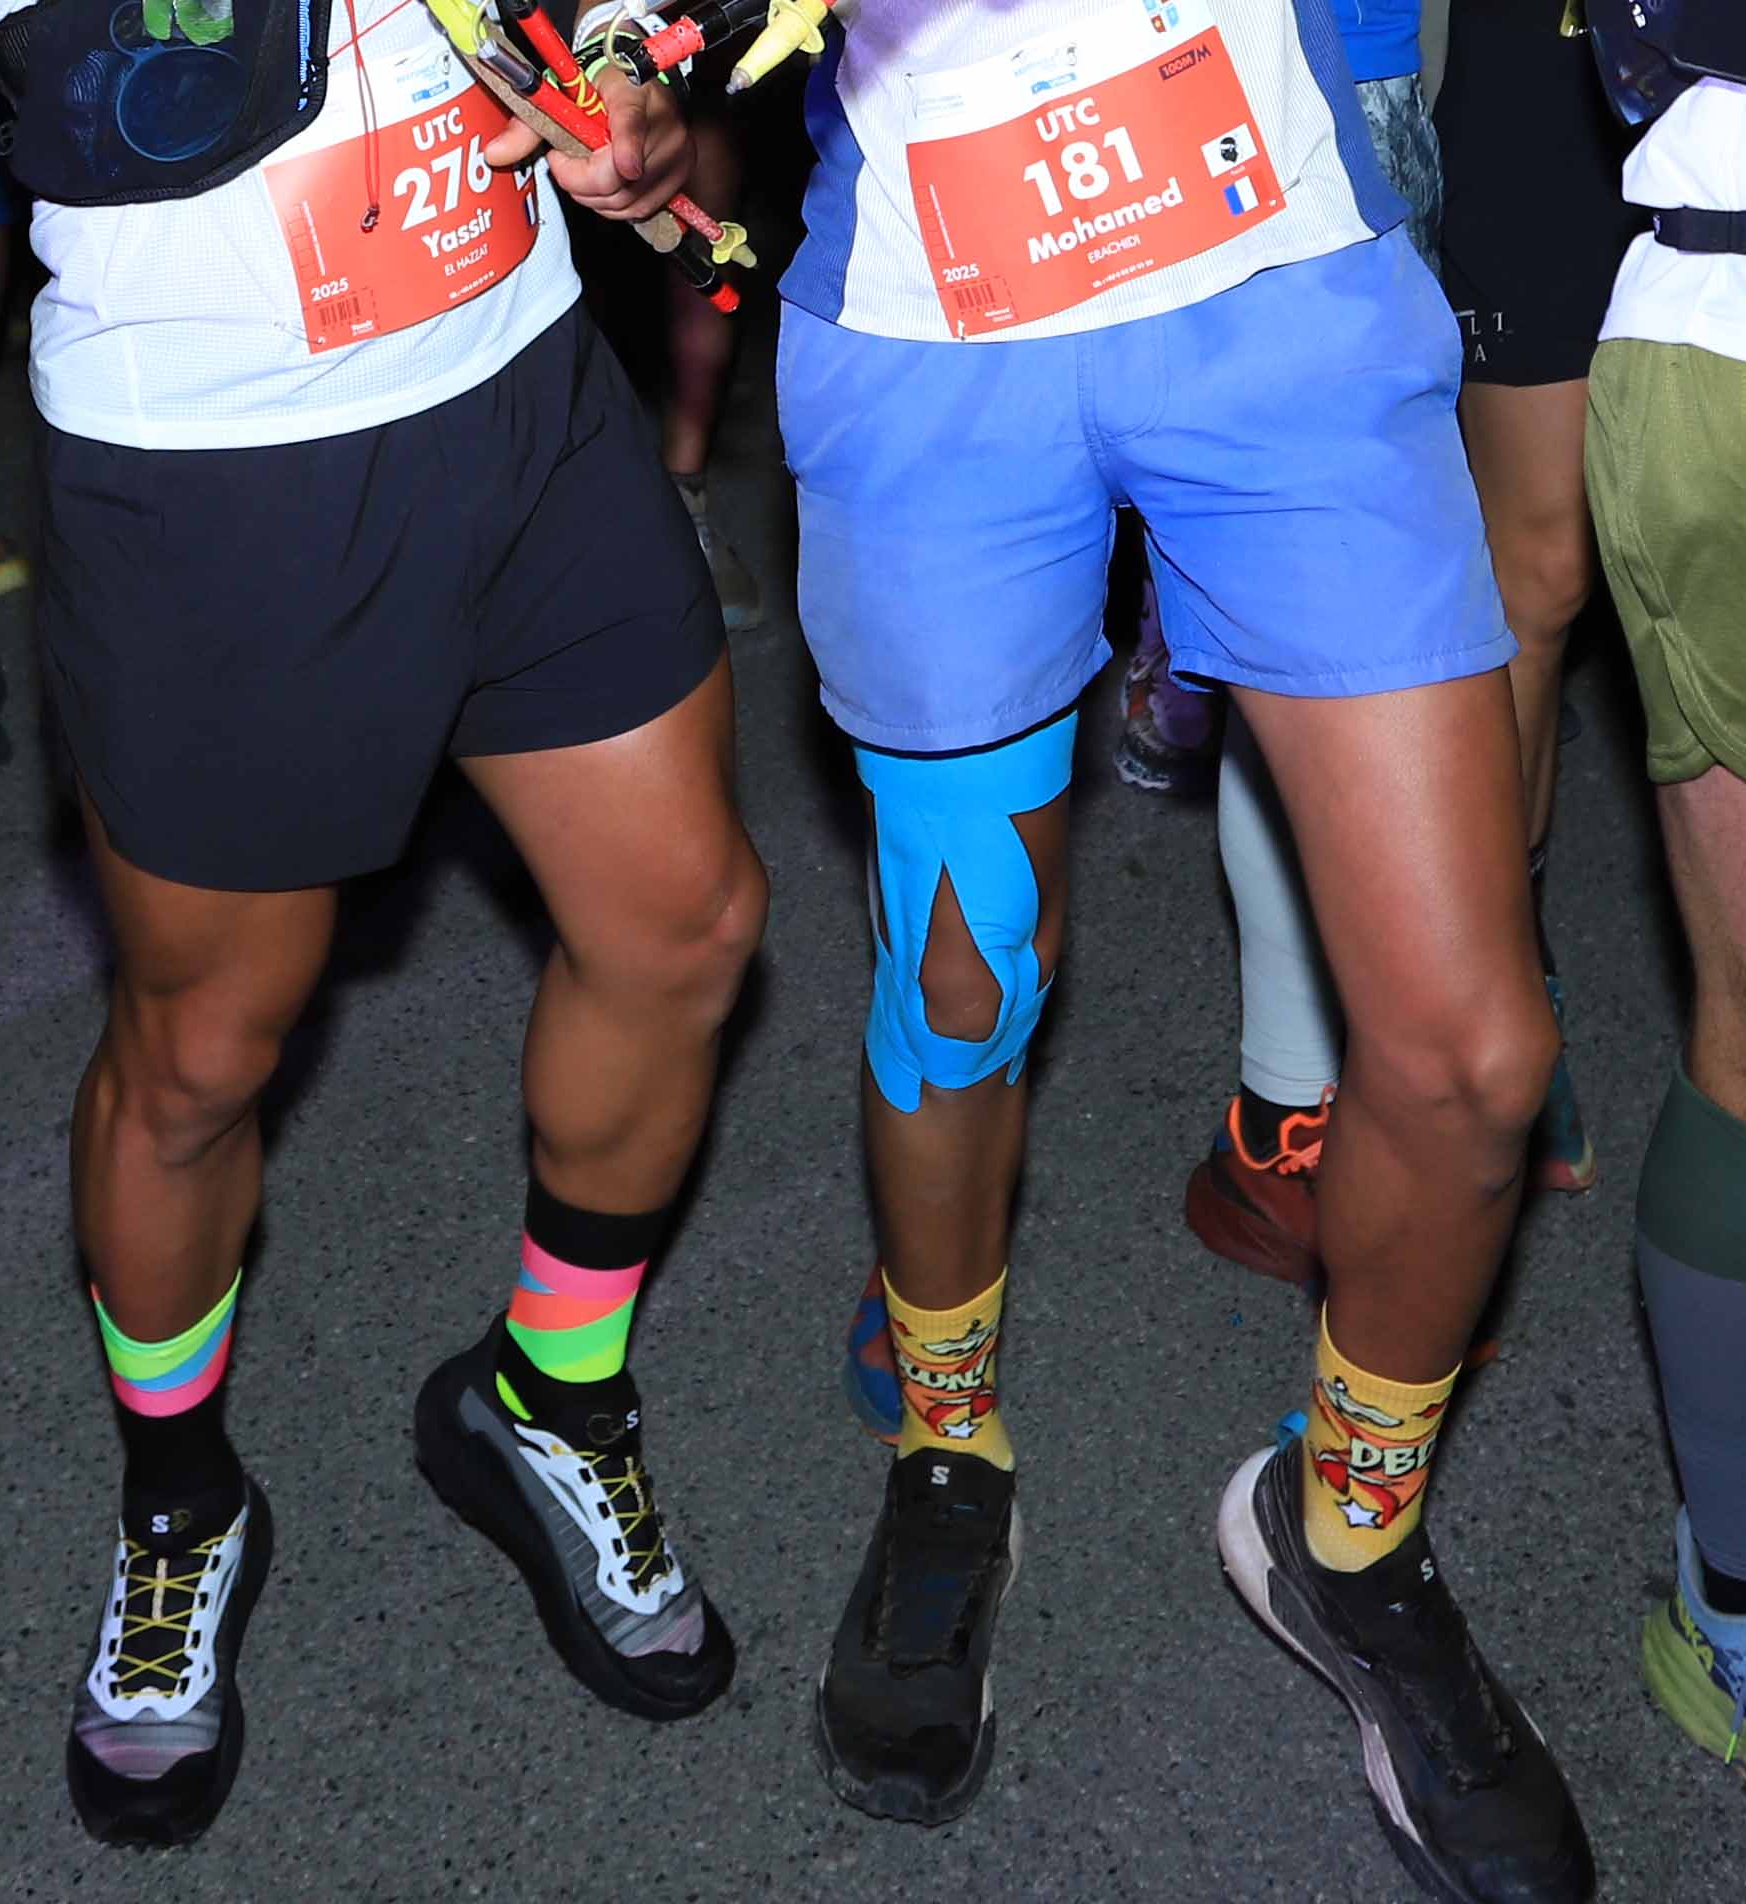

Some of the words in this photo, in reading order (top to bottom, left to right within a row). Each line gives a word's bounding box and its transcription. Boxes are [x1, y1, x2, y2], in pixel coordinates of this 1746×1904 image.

[412, 106, 466, 152] UTC
[1035, 97, 1101, 143] UTC
[392, 133, 493, 232] 276
[1022, 125, 1144, 217] 181
[421, 206, 493, 259] Yassir
[1027, 177, 1184, 265] Mohamed
[310, 276, 349, 302] 2025
[942, 263, 980, 284] 2025
